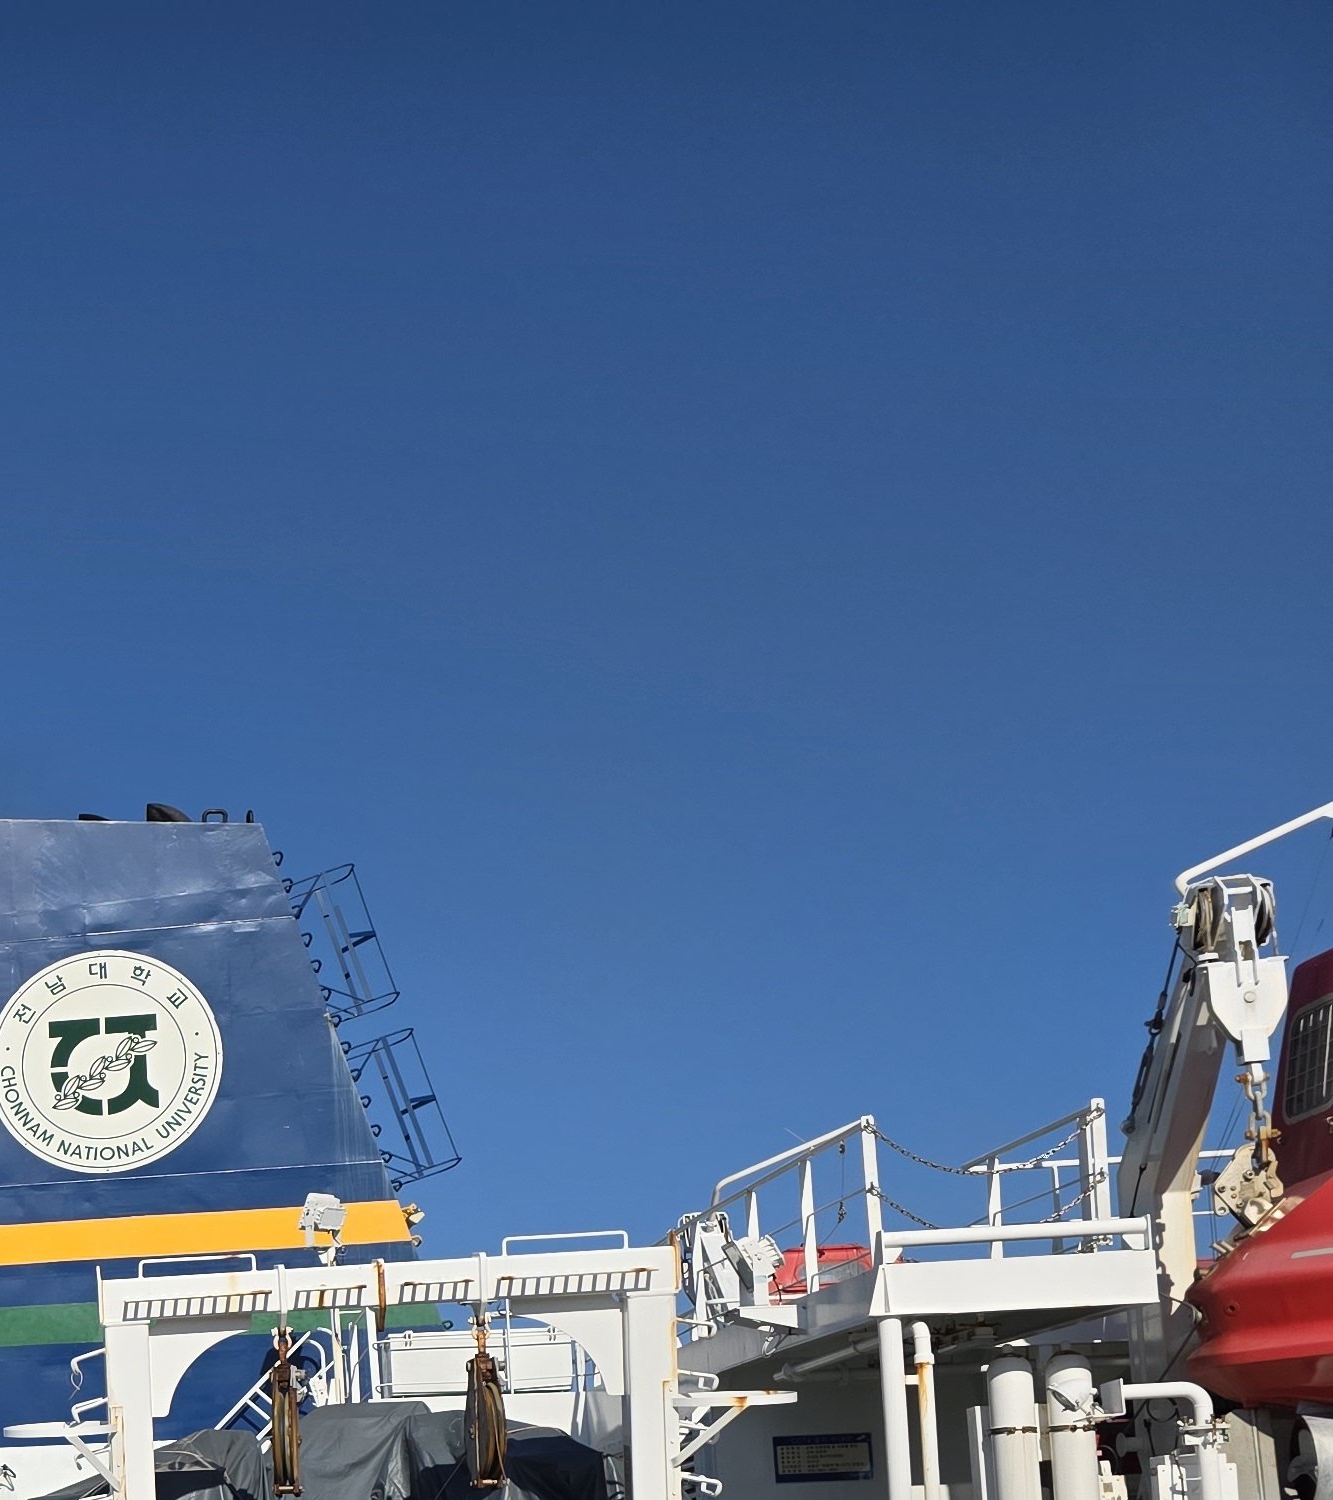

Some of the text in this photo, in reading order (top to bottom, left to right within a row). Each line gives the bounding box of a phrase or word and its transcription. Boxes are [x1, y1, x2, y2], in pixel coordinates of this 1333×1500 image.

[13, 961, 189, 1025] 전남대학교
[0, 1052, 210, 1161] CHONNAM NATIONAL UNIVERSITY
